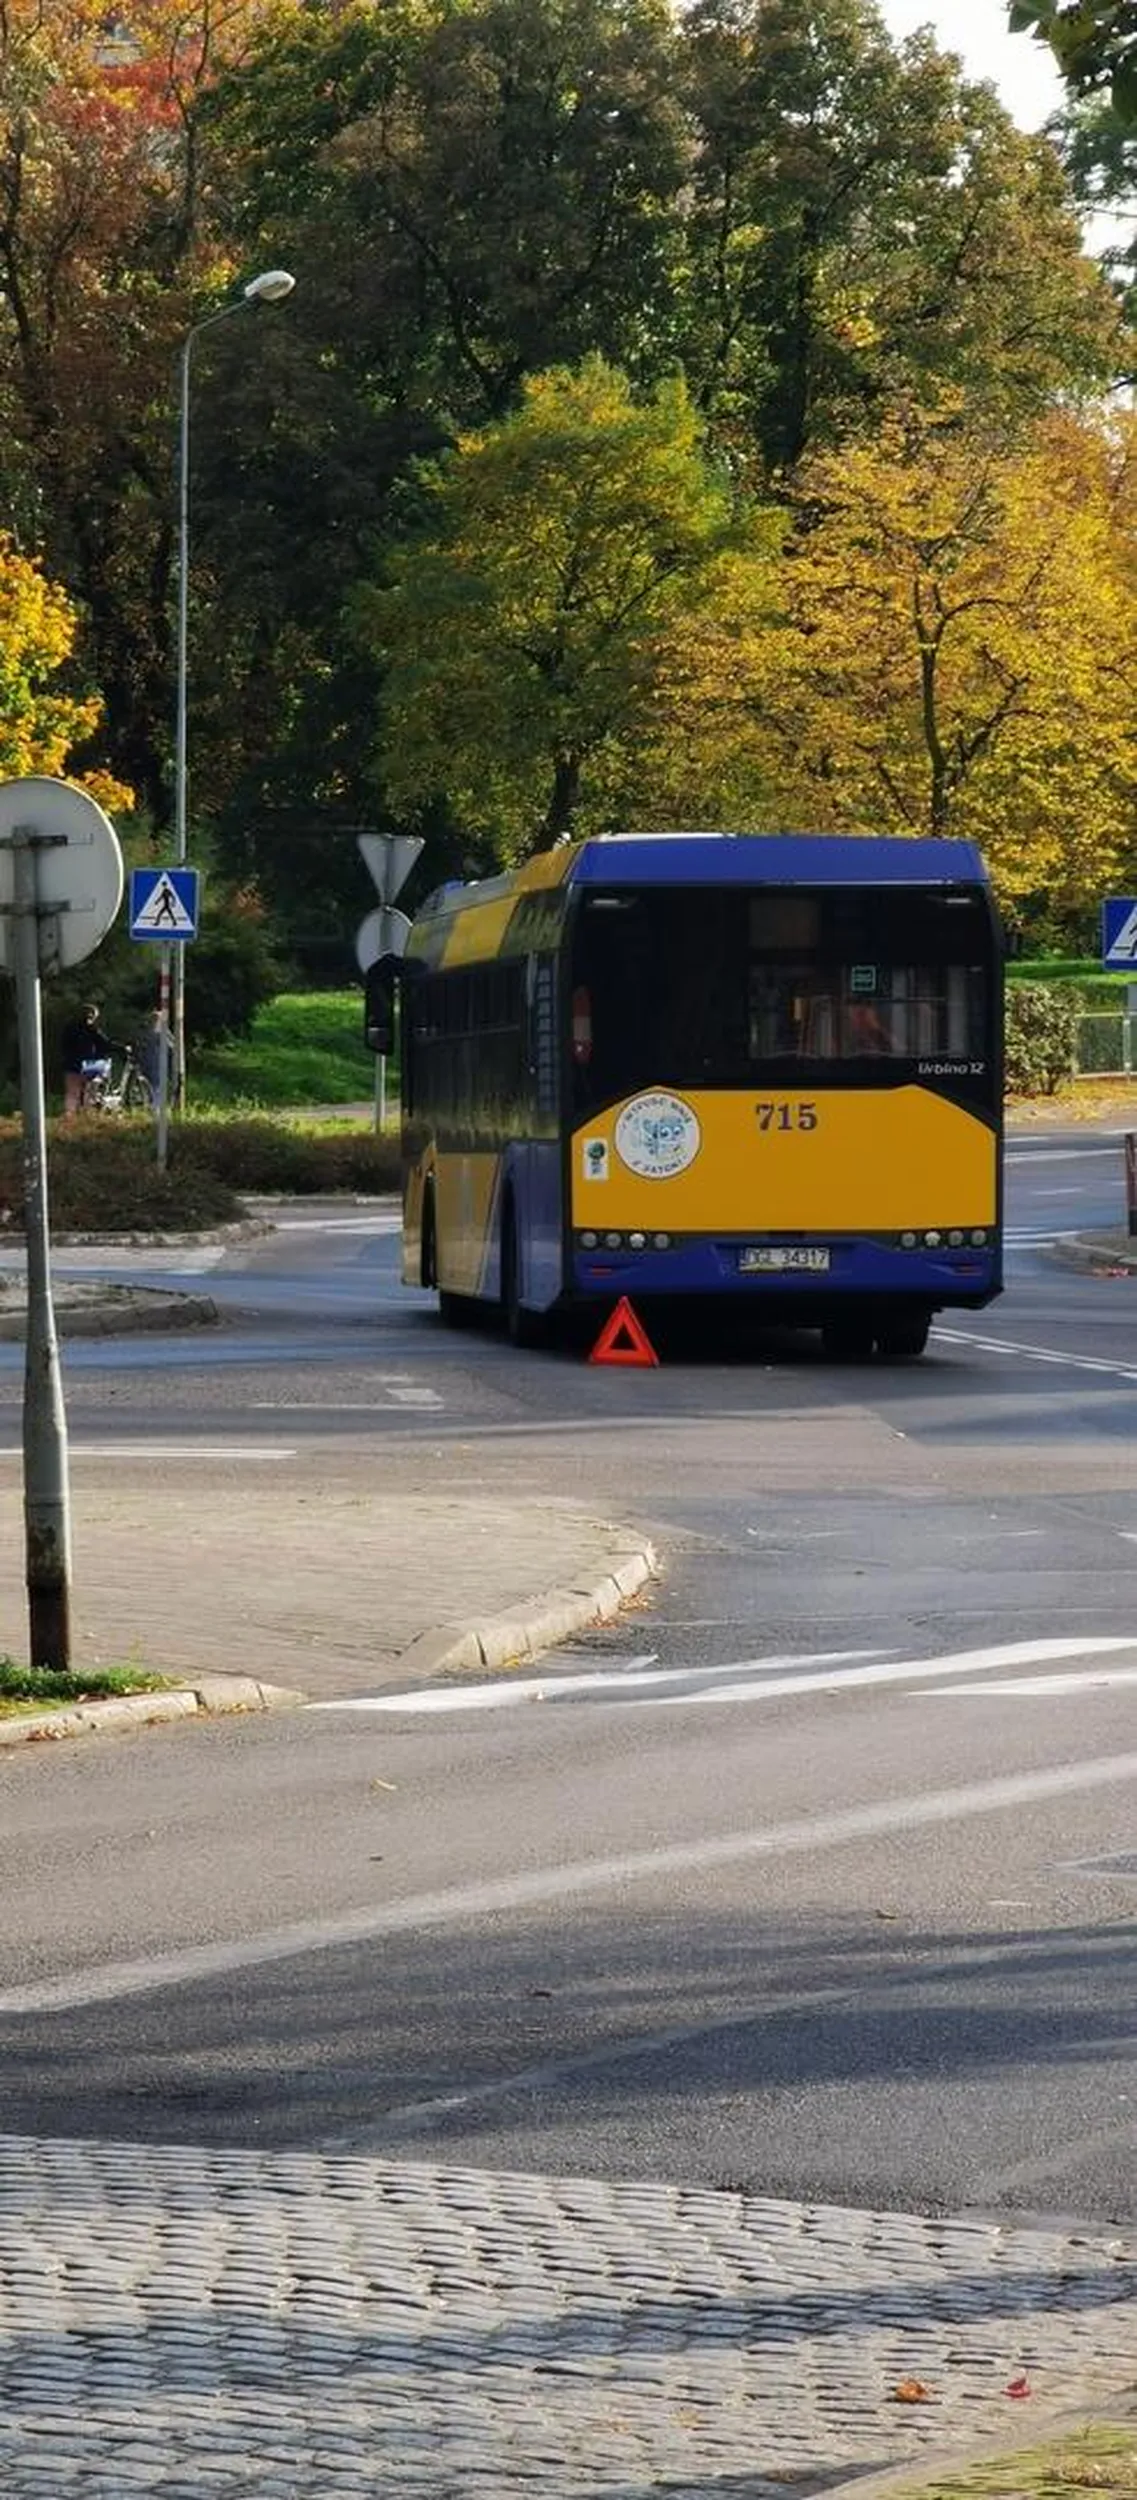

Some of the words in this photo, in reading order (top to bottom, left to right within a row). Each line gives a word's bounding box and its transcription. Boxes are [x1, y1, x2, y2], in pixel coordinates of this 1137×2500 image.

[918, 1062, 968, 1075] Urbino
[969, 1061, 985, 1075] 12
[756, 1103, 818, 1131] 715
[781, 1248, 827, 1265] 34317
